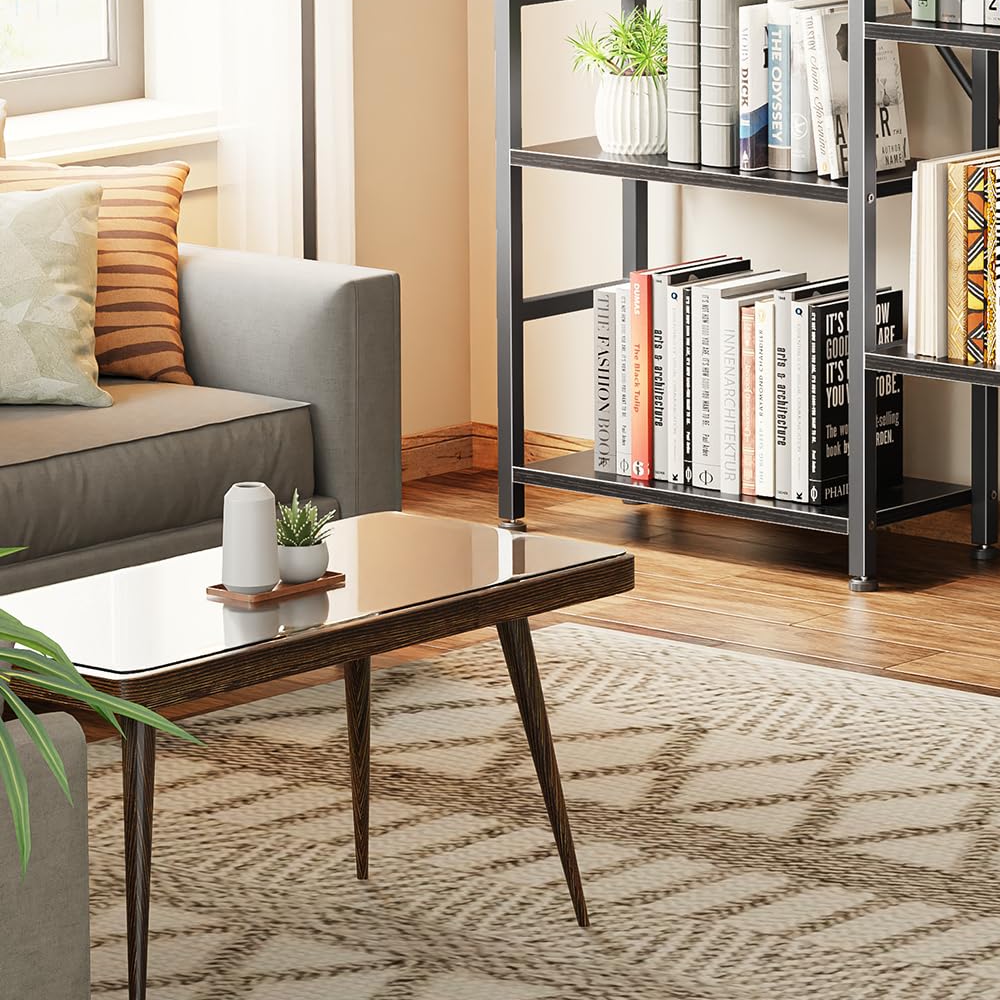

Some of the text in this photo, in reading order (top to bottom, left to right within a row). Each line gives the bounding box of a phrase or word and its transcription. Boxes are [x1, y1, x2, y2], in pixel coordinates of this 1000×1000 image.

[772, 30, 783, 142] THE ODYSSEY
[886, 154, 902, 165] NAME
[826, 312, 844, 336] IT'S
[654, 329, 665, 349] arts
[777, 347, 788, 368] arts
[598, 295, 610, 468] THE FASHION BOOK
[826, 360, 844, 384] IT'S
[654, 366, 665, 427] architecture
[724, 329, 736, 481] INNENARCHITEKTUR
[826, 384, 844, 408] YOU
[777, 384, 788, 446] architecture
[826, 424, 837, 439] The
[826, 441, 841, 457] book
